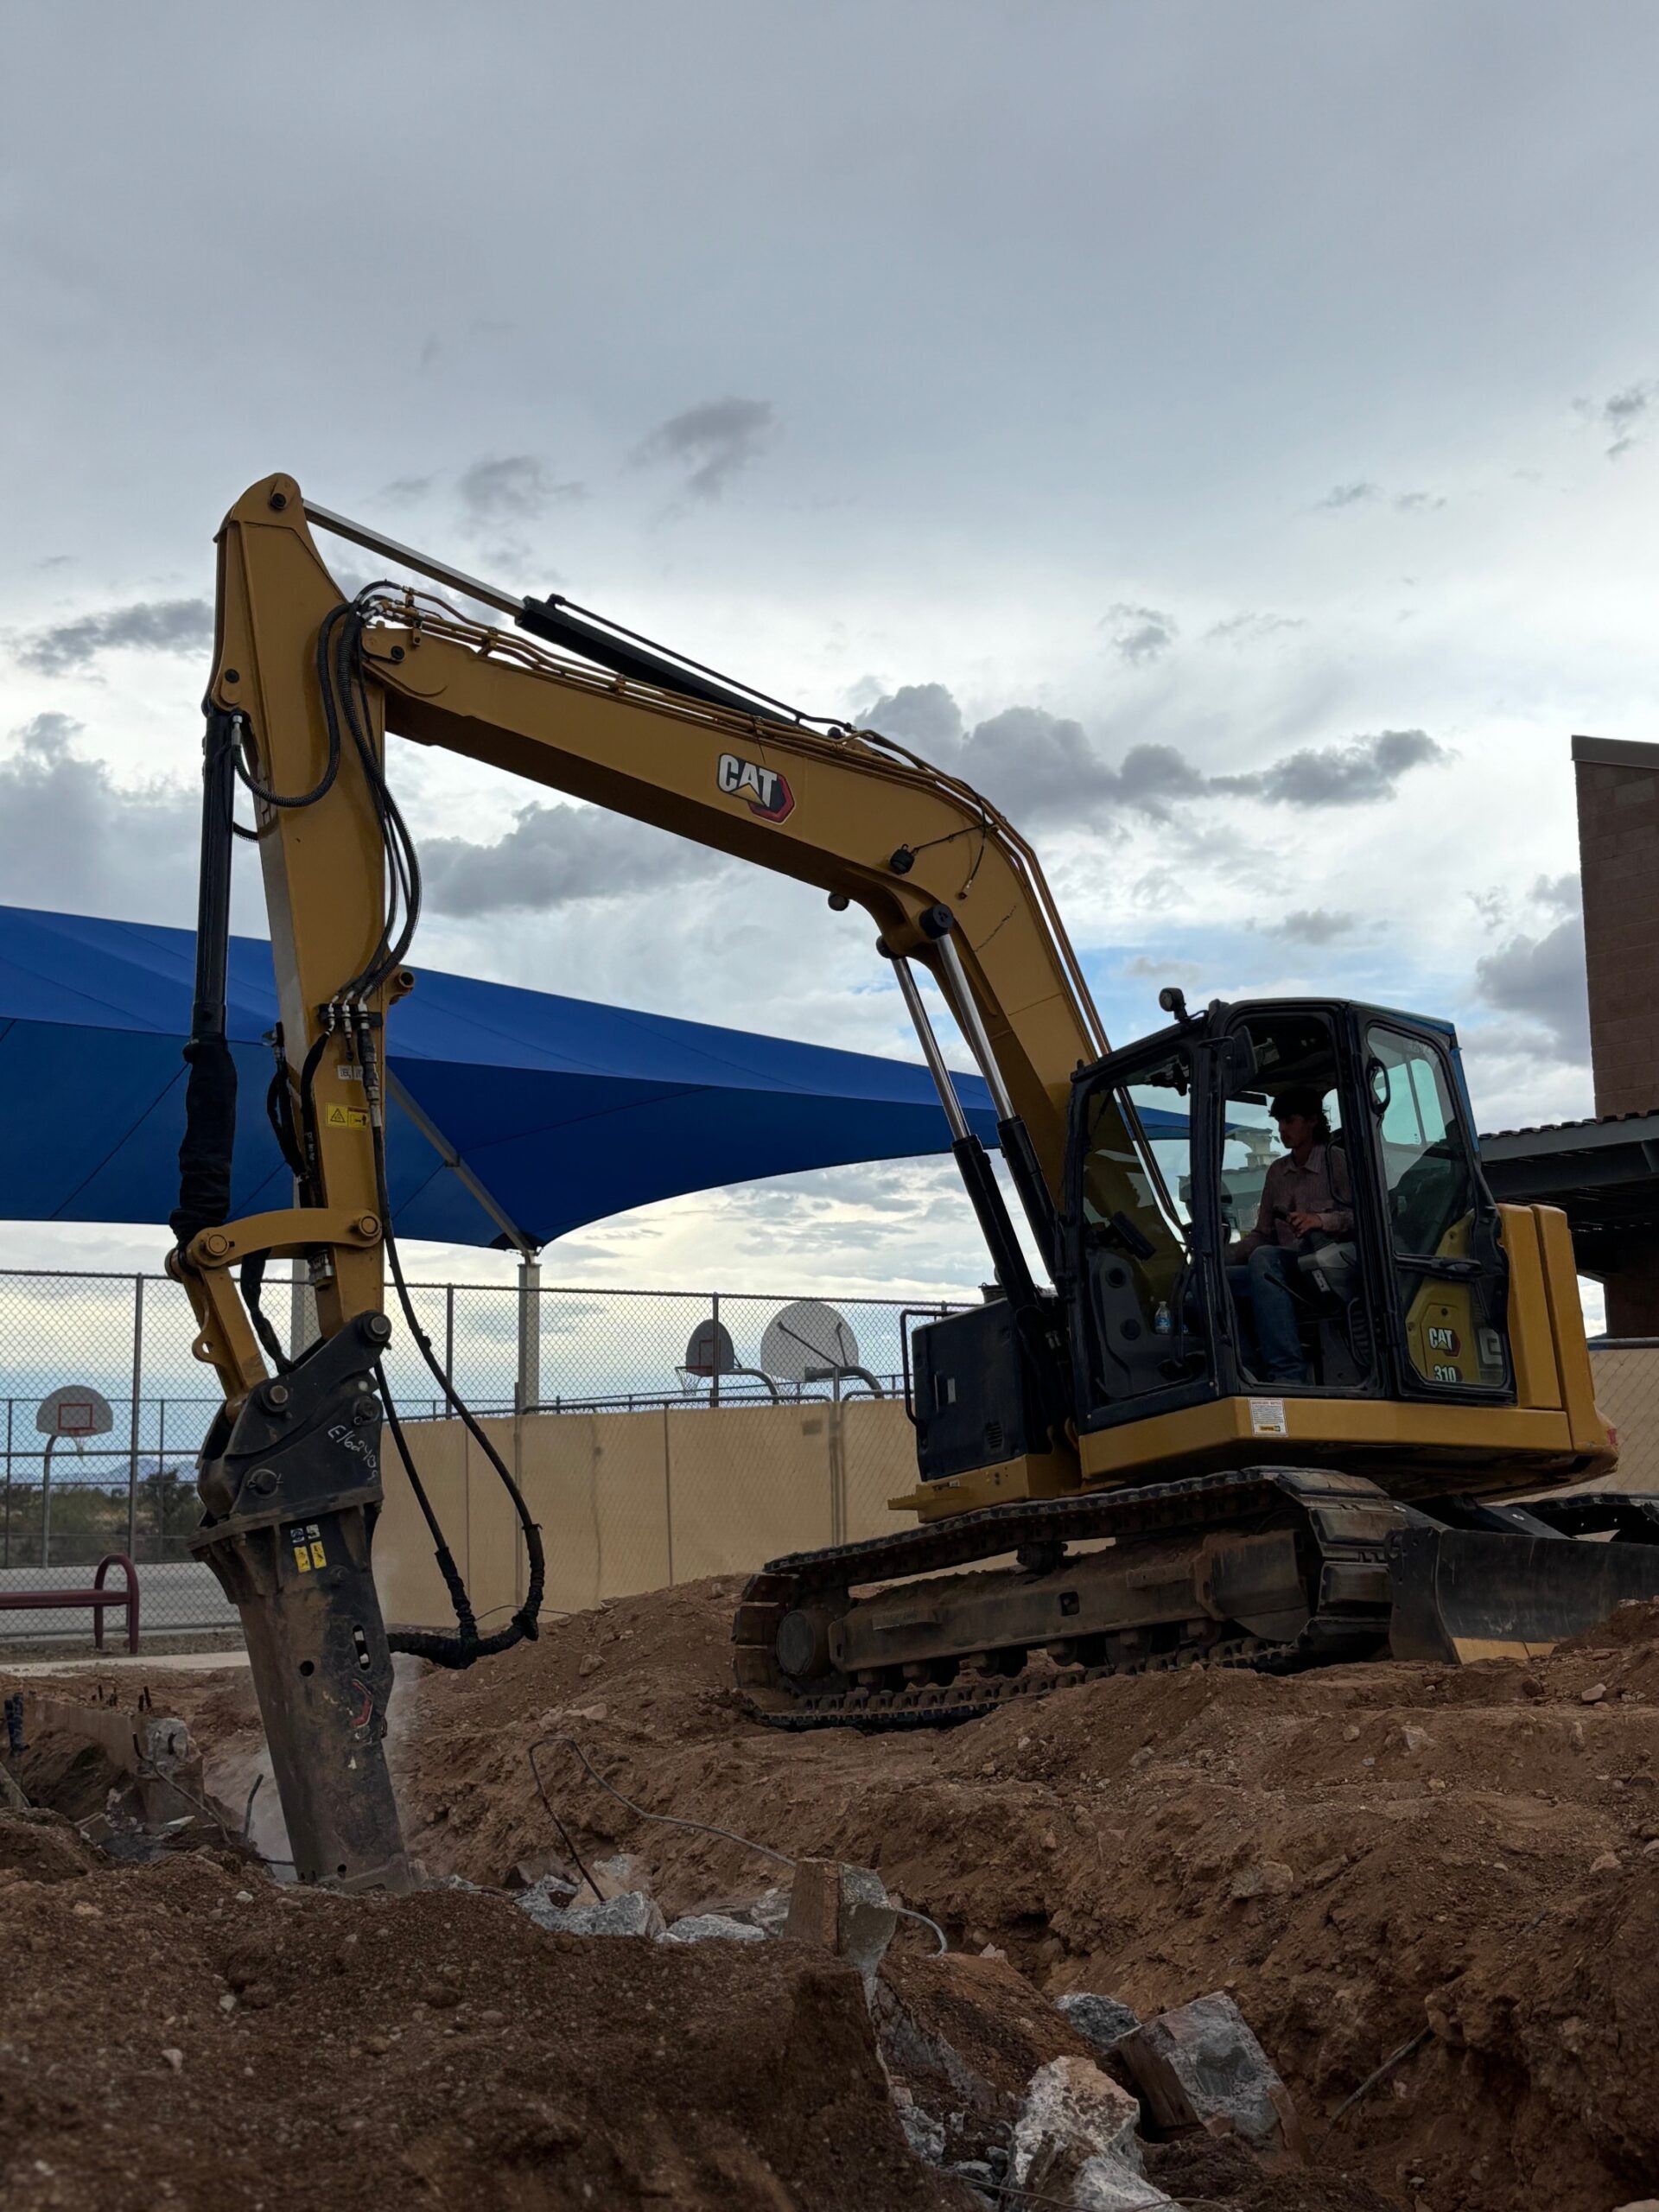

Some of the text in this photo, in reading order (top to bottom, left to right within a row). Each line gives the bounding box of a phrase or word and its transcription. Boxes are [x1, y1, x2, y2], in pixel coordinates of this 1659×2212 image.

[718, 754, 778, 807] CAT
[1428, 1327, 1452, 1351] CAT
[1434, 1365, 1457, 1382] 310
